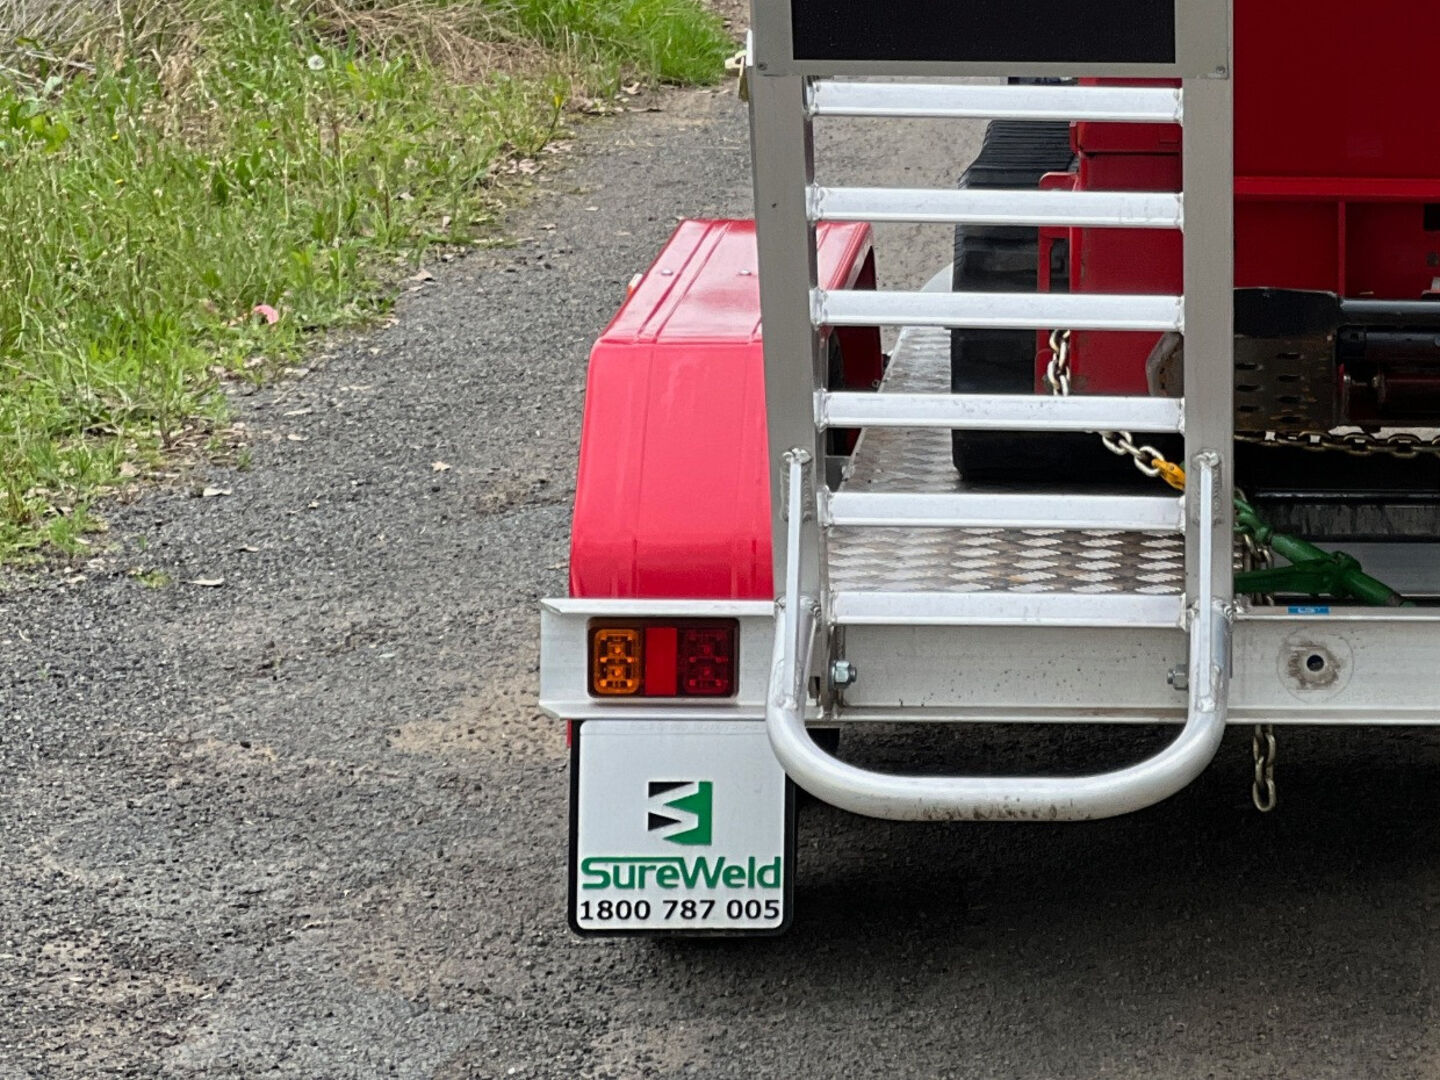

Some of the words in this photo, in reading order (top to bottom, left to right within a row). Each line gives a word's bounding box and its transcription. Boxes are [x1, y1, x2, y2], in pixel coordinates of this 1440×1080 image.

[581, 856, 782, 889] SureWeld
[580, 899, 651, 920] 1800
[662, 899, 716, 920] 787
[726, 899, 780, 920] 005
